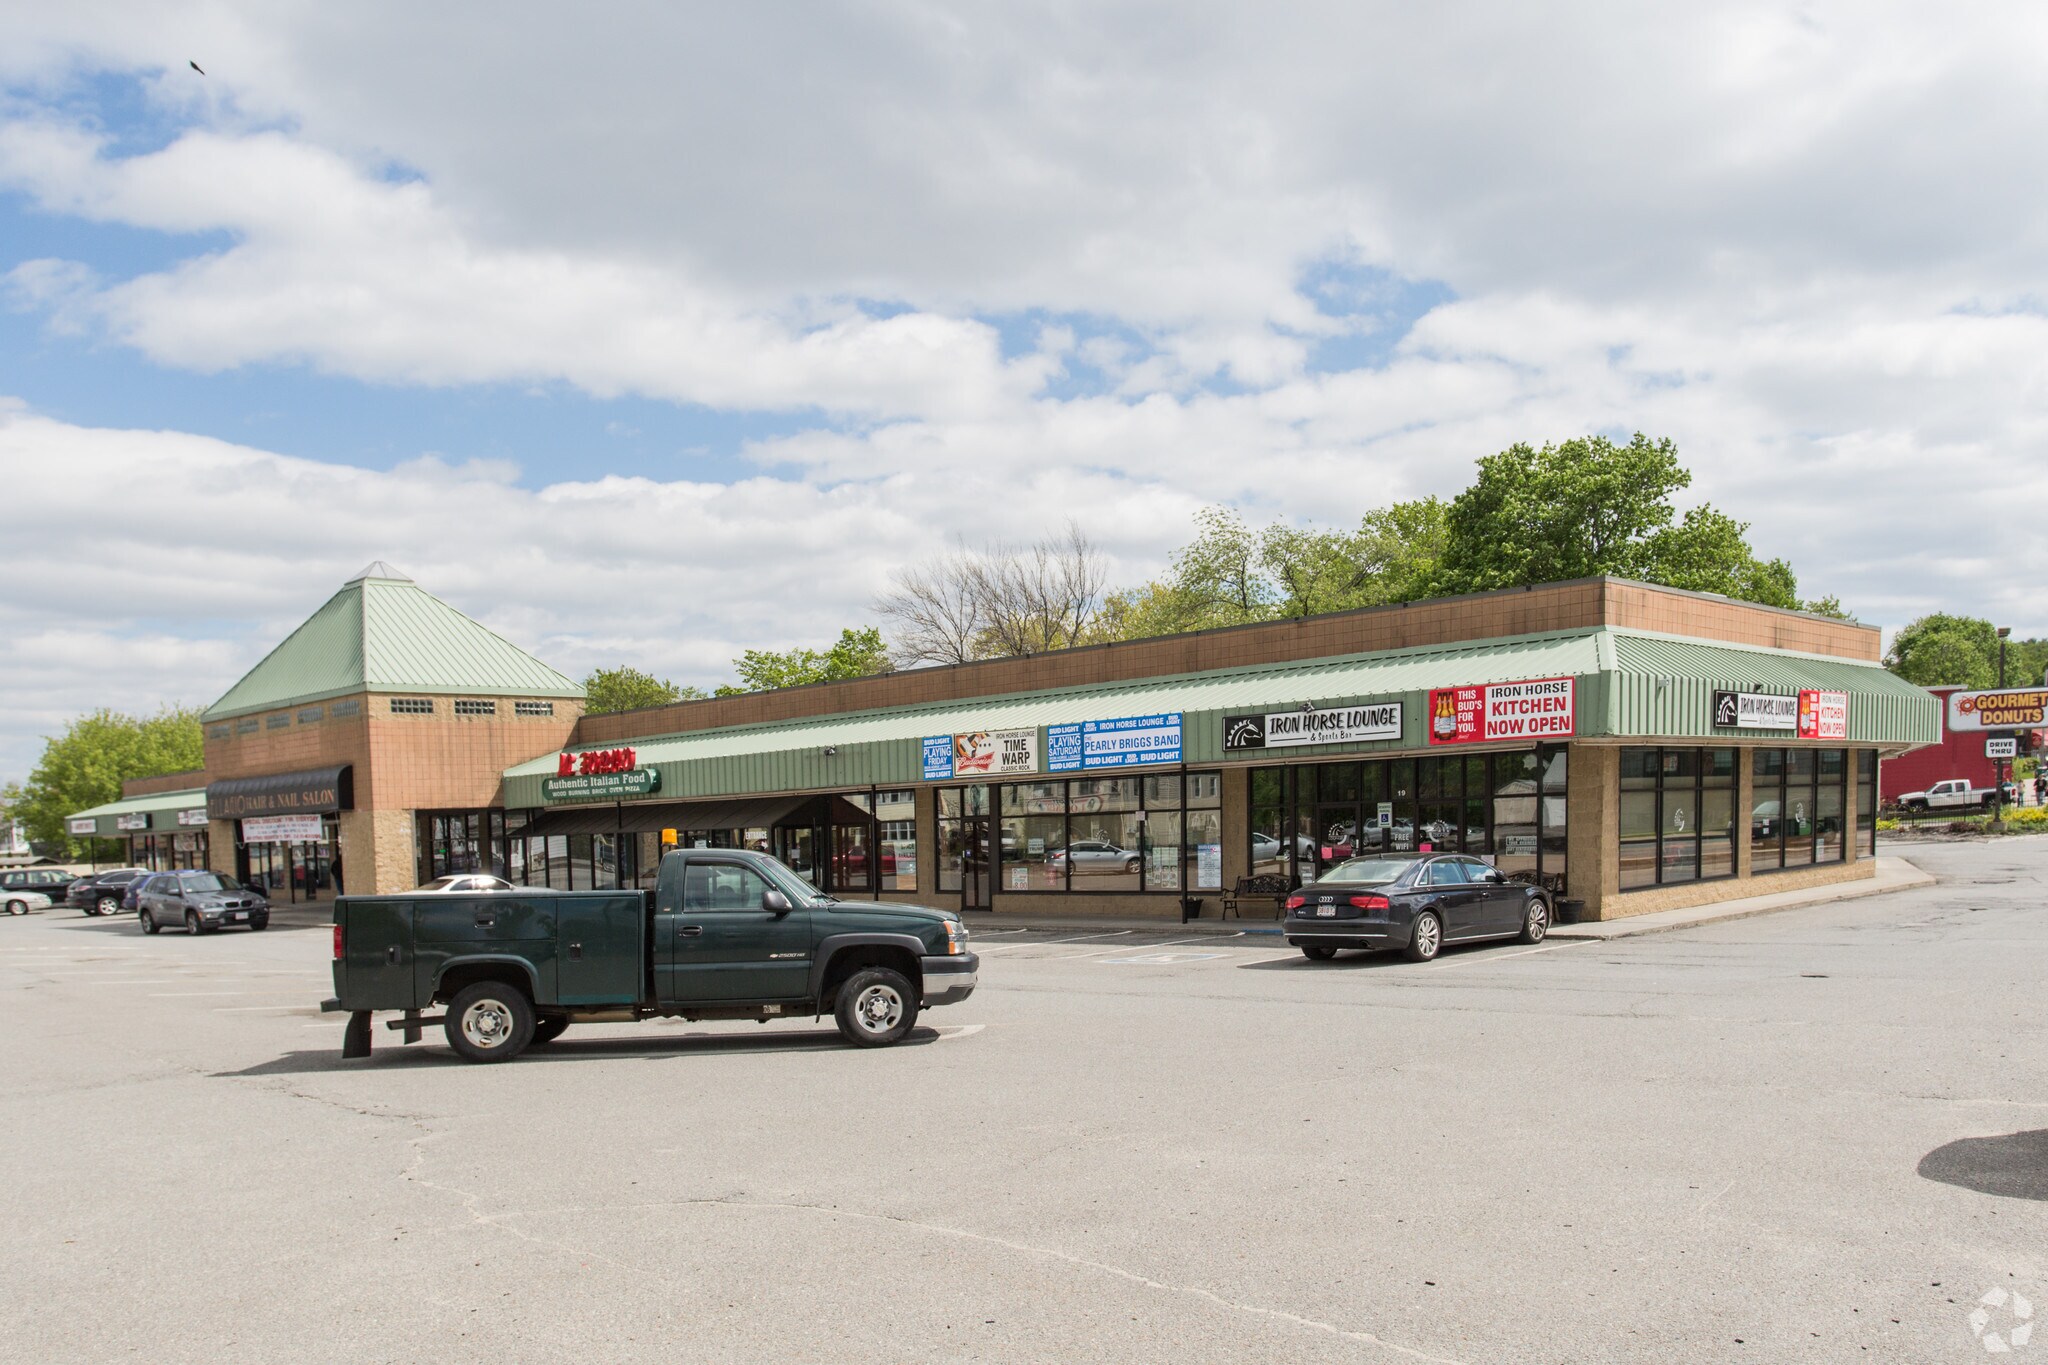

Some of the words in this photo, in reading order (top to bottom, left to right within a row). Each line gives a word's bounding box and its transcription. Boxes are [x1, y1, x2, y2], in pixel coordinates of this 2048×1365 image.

[1457, 690, 1477, 701] THIS
[1491, 686, 1521, 699] IRON
[1525, 682, 1568, 696] HORSE
[1457, 700, 1483, 711] BUD'S
[1492, 696, 1567, 717] KITCHEN
[1740, 697, 1755, 714] IRON
[1975, 692, 2048, 710] GOURMET
[1457, 711, 1474, 722] FOR
[1821, 707, 1844, 719] KITCHEN
[1981, 708, 2044, 725] DONUTS
[1099, 722, 1115, 730] IRON
[1116, 720, 1137, 729] HORSE
[1138, 717, 1164, 727] LOUNGE
[1269, 715, 1301, 735] IRON
[1302, 712, 1346, 732] HORSE
[1347, 707, 1398, 729] LOUNGE
[1487, 718, 1525, 736] NOW
[1528, 715, 1570, 733] OPEN
[1049, 727, 1061, 735] BUD
[1062, 725, 1079, 733] LIGHT
[1457, 722, 1477, 733] YOU.
[1820, 722, 1831, 734] NOW
[1833, 722, 1845, 735] OPEN
[924, 738, 934, 746] BUD
[934, 737, 950, 745] LIGHT
[1004, 739, 1027, 752] TIME
[1048, 735, 1081, 748] PLAYING
[1084, 740, 1117, 753] PEARLY
[1119, 736, 1152, 749] BRIGGS
[1154, 734, 1180, 747] BAND
[924, 746, 952, 758] PLAYING
[1048, 746, 1081, 757] SATURDAY
[1140, 752, 1156, 761] BUD
[1157, 750, 1180, 760] LIGHT
[928, 757, 947, 766] FRIDAY
[1002, 752, 1030, 765] WARP
[1085, 757, 1101, 765] BUD
[1102, 755, 1123, 764] LIGHT
[1050, 762, 1062, 770] BUD
[1063, 761, 1080, 769] LIGHT
[548, 777, 588, 790] Authentic
[590, 775, 620, 787] Italian
[622, 772, 645, 784] Food
[269, 796, 275, 809] &
[278, 793, 300, 808] NAIL
[303, 789, 334, 806] SALON
[1398, 789, 1406, 797] 19
[746, 831, 767, 840] ENTRANCE
